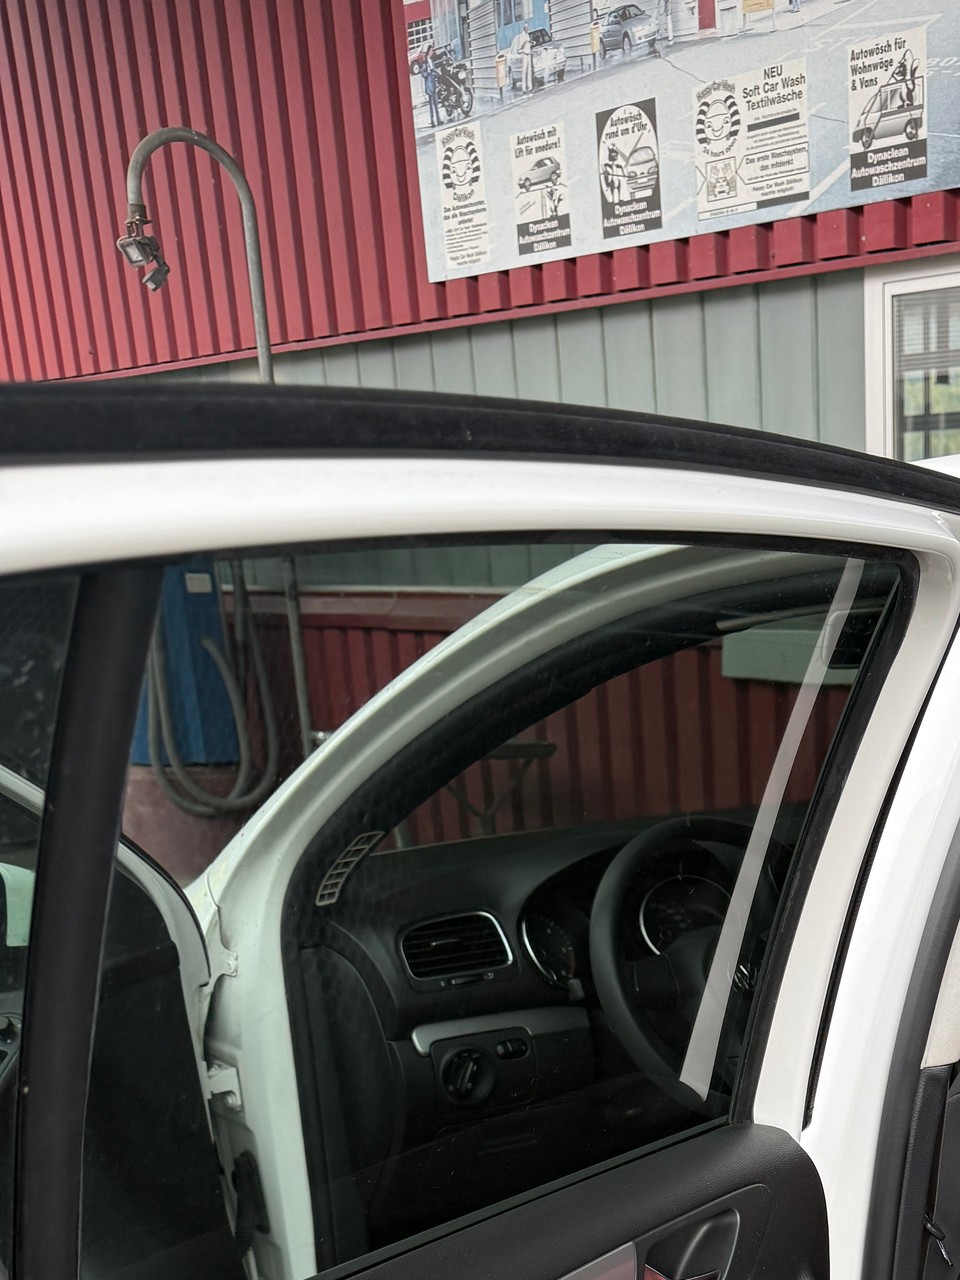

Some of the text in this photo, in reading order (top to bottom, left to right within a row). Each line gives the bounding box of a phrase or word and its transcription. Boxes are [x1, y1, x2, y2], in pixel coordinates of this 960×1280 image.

[850, 40, 892, 62] Autowösch
[894, 37, 907, 51] für
[763, 64, 783, 80] NEU
[850, 57, 894, 77] Wohnwäge
[742, 73, 806, 99] Soft Car Wash
[851, 76, 878, 91] & Vans
[746, 89, 803, 111] Textilwäsche
[547, 126, 557, 138] mit
[605, 127, 619, 140] rund
[620, 128, 630, 136] um
[525, 145, 533, 156] für
[867, 147, 909, 164] Dynaclean
[851, 156, 927, 179] Autowaschzentrum
[614, 201, 648, 216] Dynaclean
